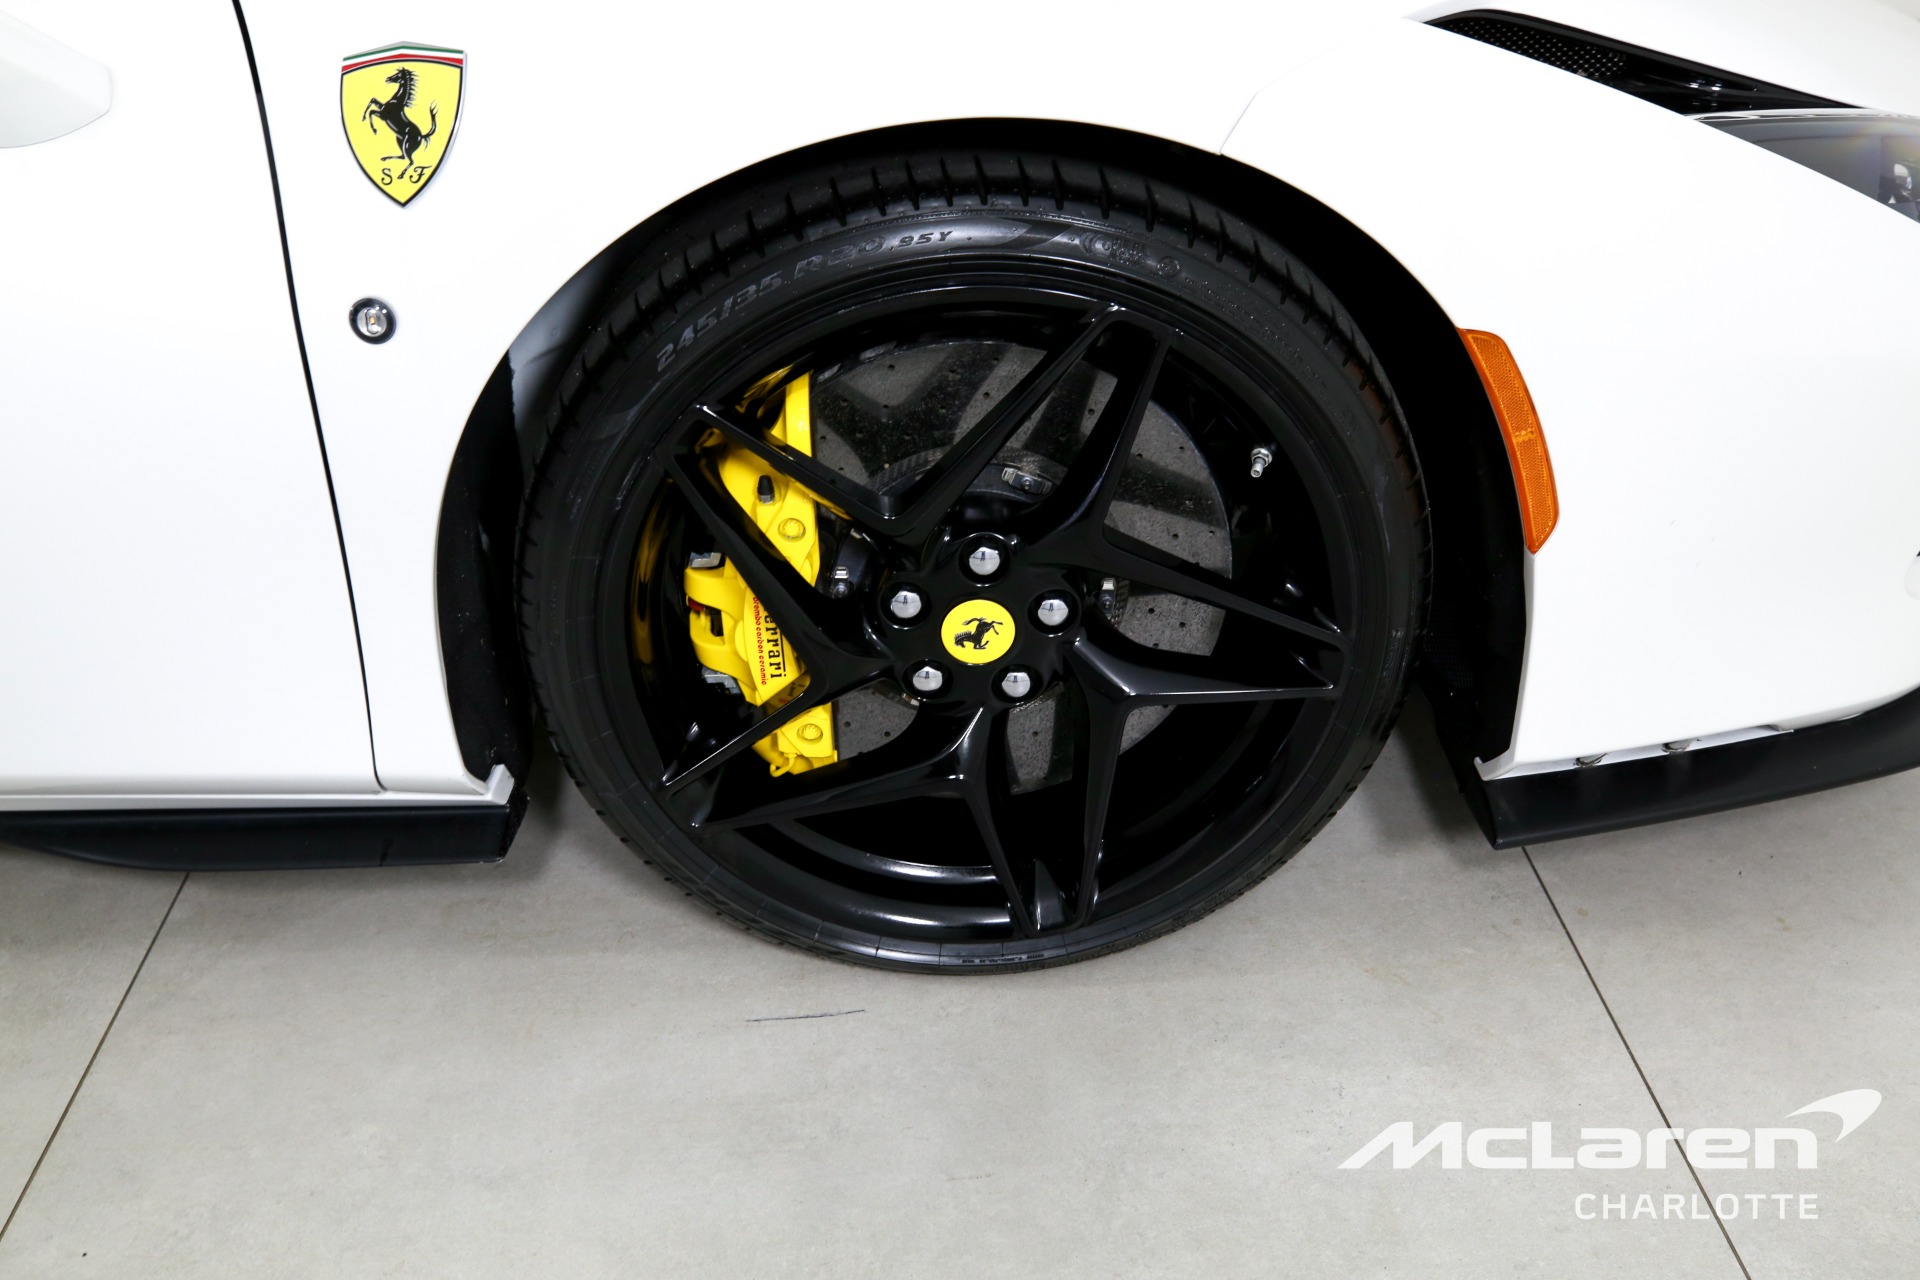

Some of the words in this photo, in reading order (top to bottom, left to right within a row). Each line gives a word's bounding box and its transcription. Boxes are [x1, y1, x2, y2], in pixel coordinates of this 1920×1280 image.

[656, 270, 783, 373] 245/35
[793, 235, 887, 281] R20
[896, 230, 954, 249] 95Y
[756, 627, 765, 654] carbon
[764, 611, 787, 678] errari
[759, 655, 769, 686] ceramic
